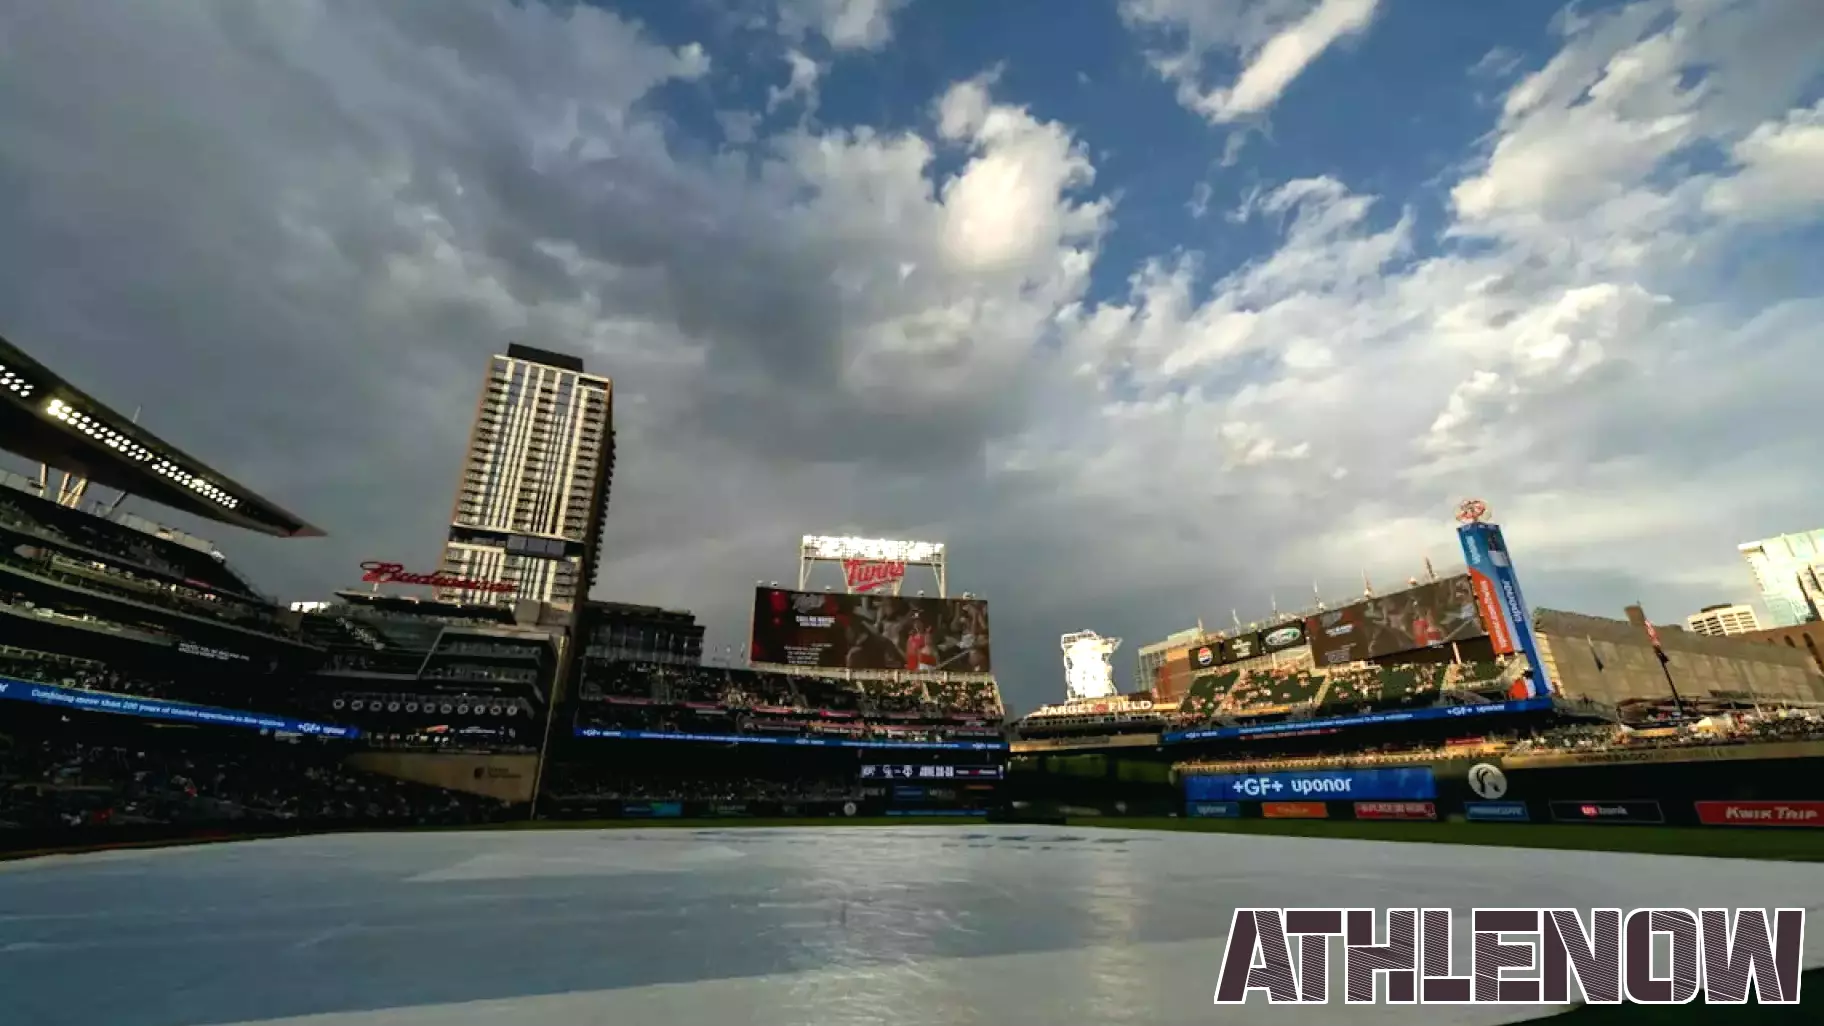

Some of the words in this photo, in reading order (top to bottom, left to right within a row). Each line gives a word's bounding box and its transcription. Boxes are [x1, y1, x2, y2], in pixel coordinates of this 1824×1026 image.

[360, 562, 518, 592] Budweiser
[843, 559, 904, 589] Twins
[1040, 704, 1093, 715] TARGET
[1109, 701, 1152, 712] FIELD
[1291, 777, 1352, 795] uponor
